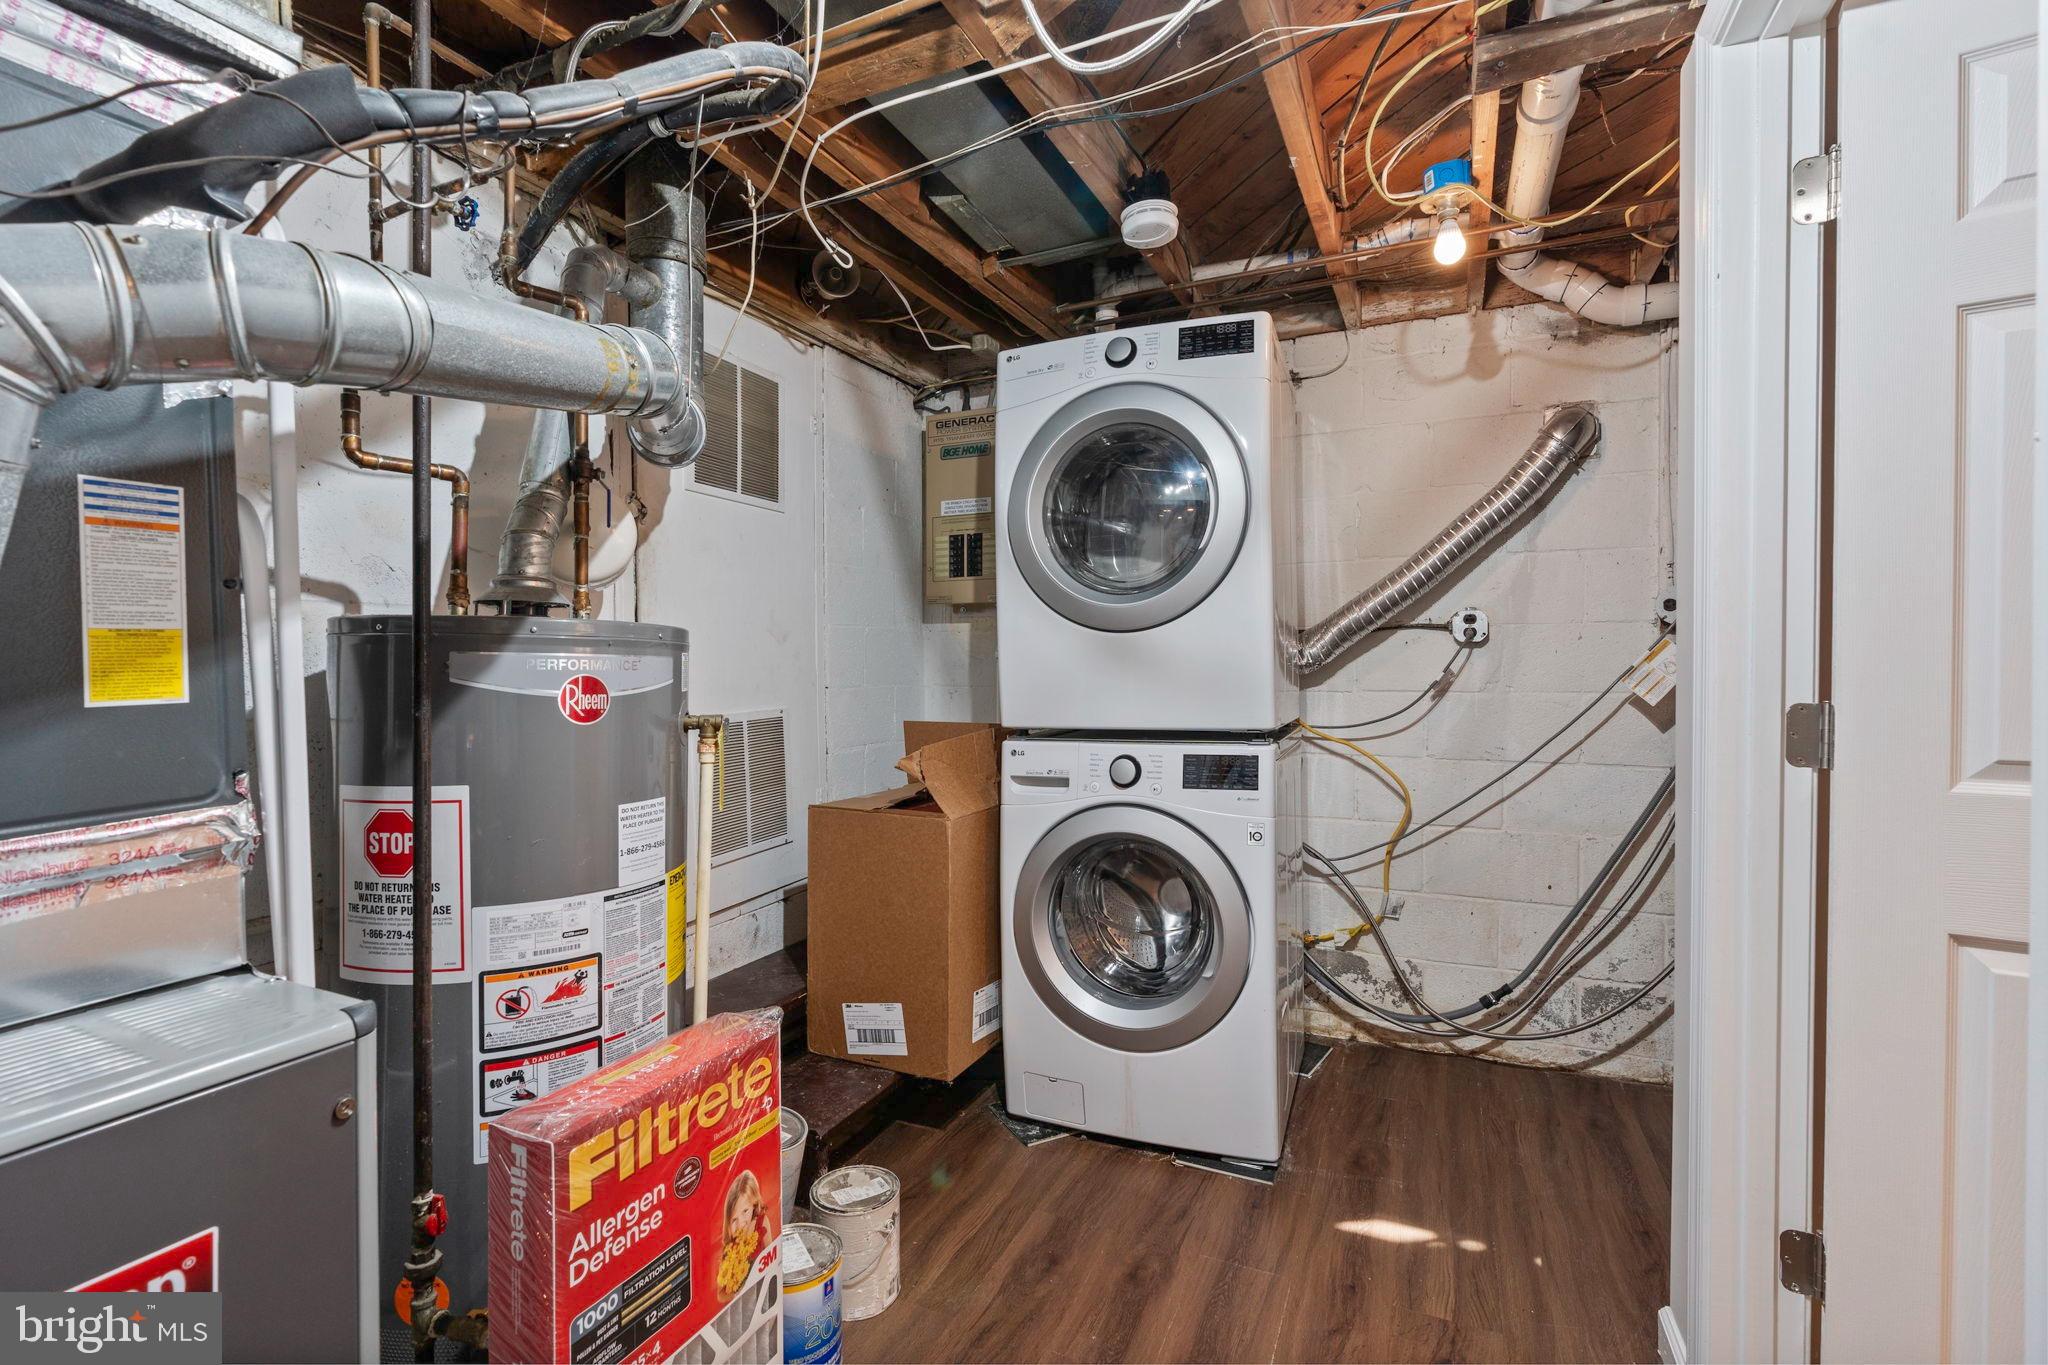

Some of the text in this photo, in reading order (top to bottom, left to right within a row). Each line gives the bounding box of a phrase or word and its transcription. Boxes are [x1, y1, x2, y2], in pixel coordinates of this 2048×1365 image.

[936, 415, 995, 429] GENERAC
[943, 443, 989, 458] BGE HOME
[527, 658, 639, 671] PERFORMANCE
[566, 676, 607, 716] Rheem
[369, 831, 414, 855] STOP
[354, 880, 363, 890] DO
[364, 881, 379, 892] NOT
[382, 882, 414, 893] RETURN
[358, 892, 383, 904] WATER
[385, 894, 413, 904] HEATE
[348, 902, 360, 914] THE
[361, 904, 387, 915] PLACE
[388, 906, 398, 915] OF
[528, 965, 569, 977] WARNING
[532, 1051, 567, 1063] DANGER
[569, 1056, 772, 1213] Filtrete
[510, 1142, 528, 1262] Filtrete
[568, 1183, 666, 1262] Allergen
[569, 1209, 663, 1289] Defense
[757, 1245, 777, 1274] 3M
[623, 1264, 666, 1300] FILTRATION
[576, 1293, 618, 1335] 1000
[644, 1310, 657, 1328] 12
[657, 1296, 682, 1319] MONTHS
[593, 1341, 617, 1364] AIRFLOW
